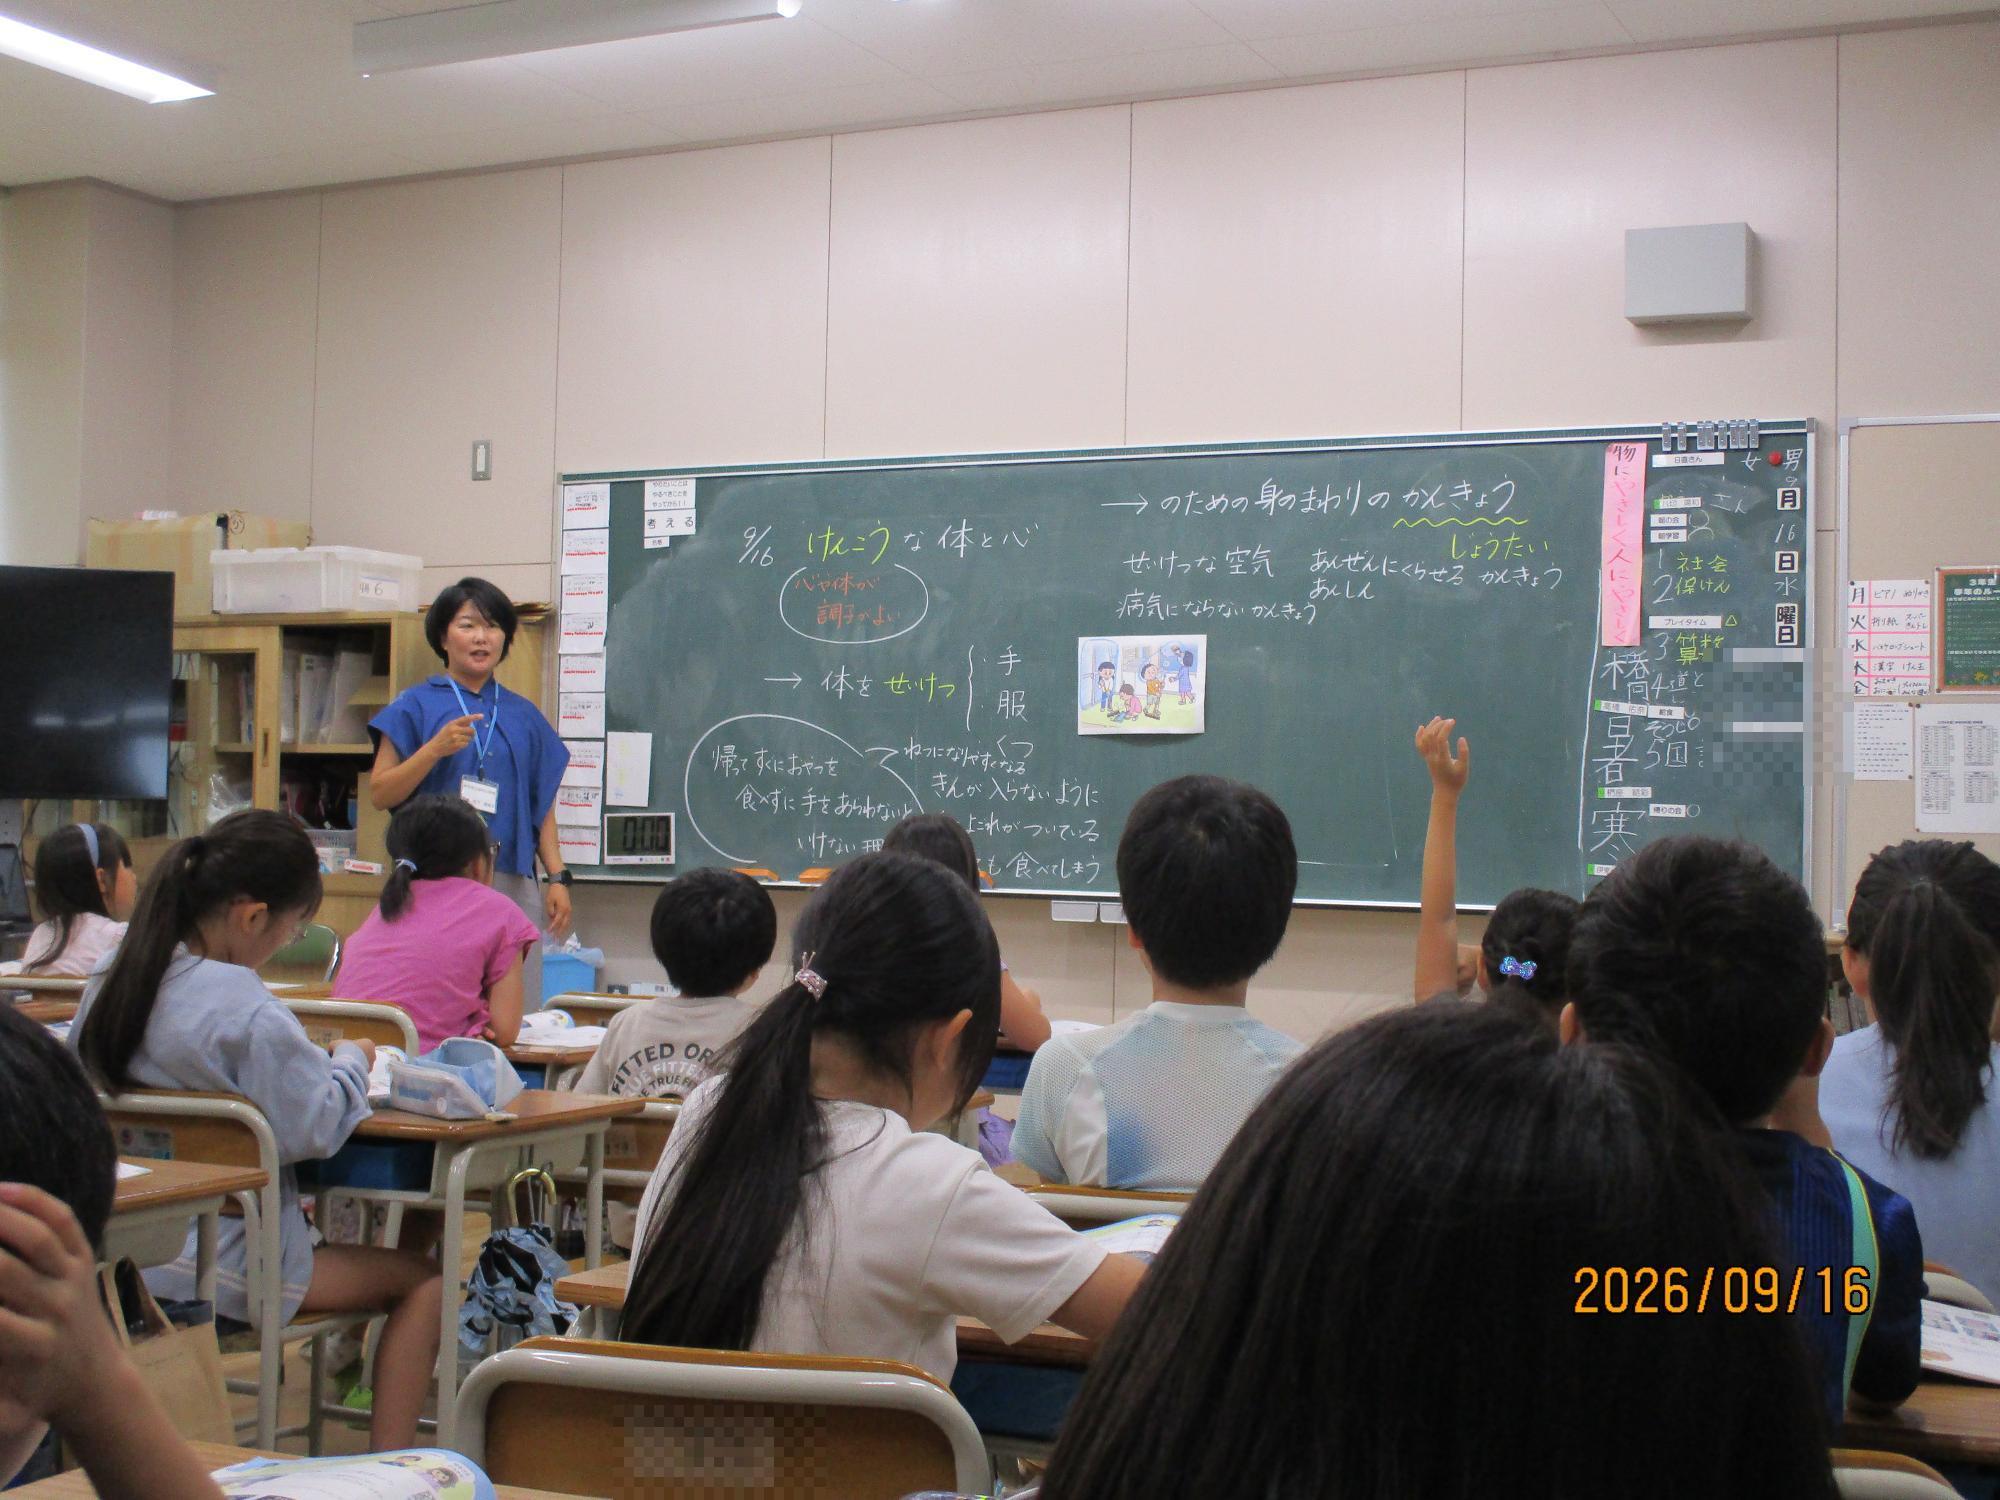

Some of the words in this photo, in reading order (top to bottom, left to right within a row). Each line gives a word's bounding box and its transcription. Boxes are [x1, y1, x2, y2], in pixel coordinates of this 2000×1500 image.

[1783, 448, 1803, 471] 男
[647, 516, 694, 530] 考える
[1452, 532, 1549, 561] じょうたい
[1123, 544, 1274, 578] せいけつな空気
[1677, 552, 1728, 573] 社会
[1310, 577, 1375, 600] あんしん
[1675, 577, 1730, 596] 保けん
[1664, 617, 1706, 626] プレイタイム
[1851, 615, 1867, 630] 火
[997, 644, 1021, 676] 手
[821, 665, 955, 702] 体をせいけつ
[997, 690, 1028, 722] 服
[997, 735, 1034, 758] くつ
[976, 851, 1101, 884] も食べてしまう
[611, 1043, 675, 1095] FITTED
